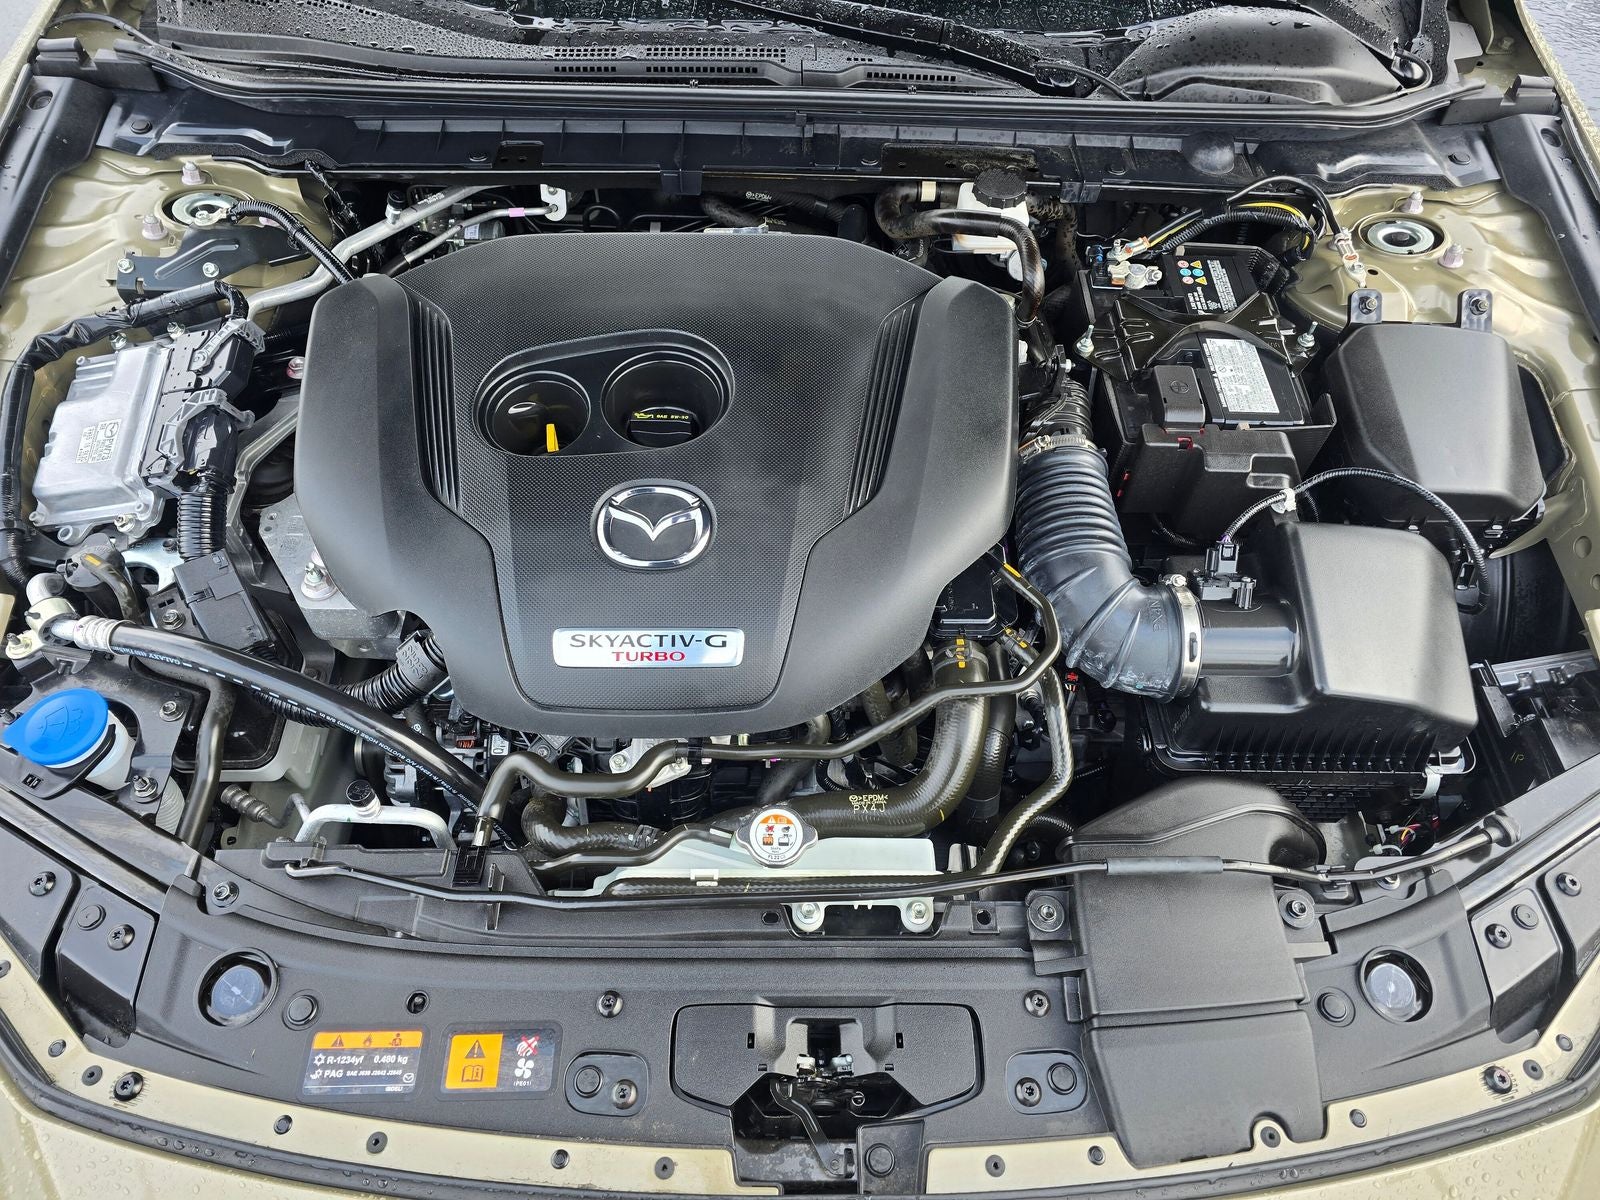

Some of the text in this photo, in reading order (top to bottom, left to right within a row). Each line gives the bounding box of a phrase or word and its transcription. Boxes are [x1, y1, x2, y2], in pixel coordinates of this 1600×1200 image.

[569, 634, 728, 648] SKYACTIV-G
[611, 651, 686, 662] TURBO
[853, 803, 886, 814] PX4J
[326, 1055, 365, 1066] R-1234yf
[397, 1055, 409, 1065] kg
[323, 1069, 344, 1078] PAG
